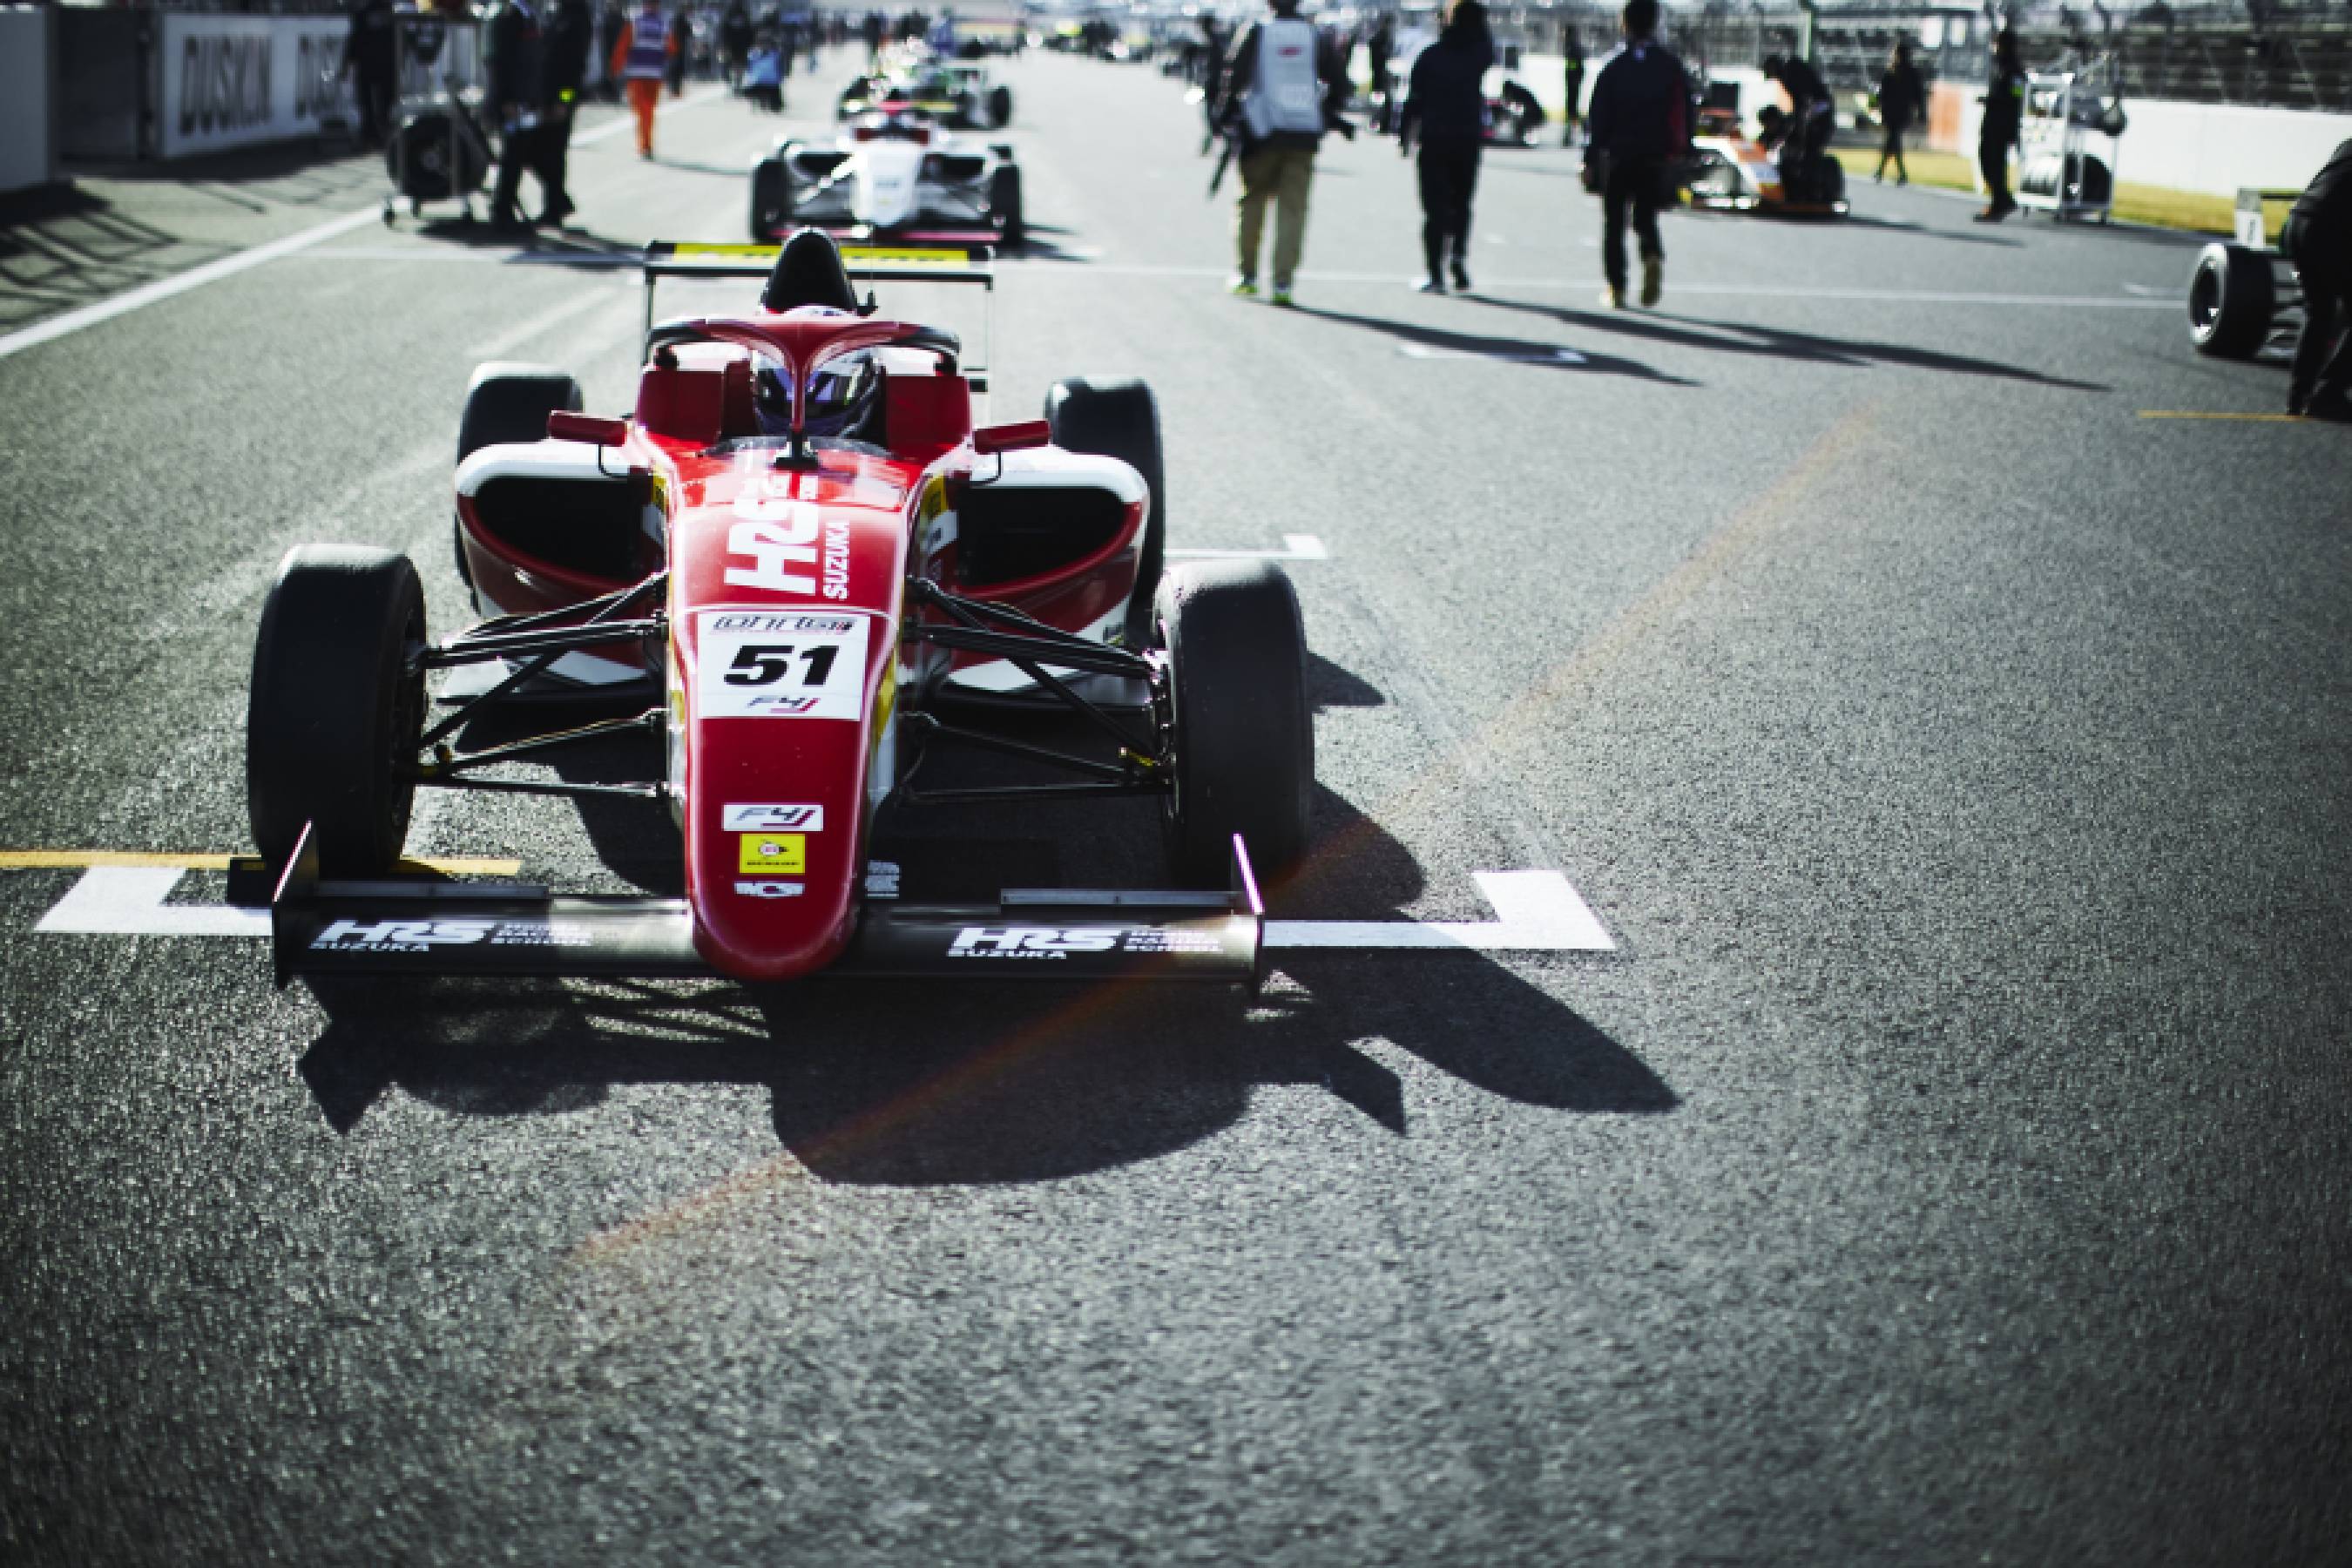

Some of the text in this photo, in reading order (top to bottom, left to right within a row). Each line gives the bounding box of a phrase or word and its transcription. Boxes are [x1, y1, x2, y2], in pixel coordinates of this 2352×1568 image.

[824, 523, 850, 600] SUZUKA
[724, 645, 839, 686] 51
[314, 919, 496, 943] HRS
[952, 927, 1121, 950] HRS
